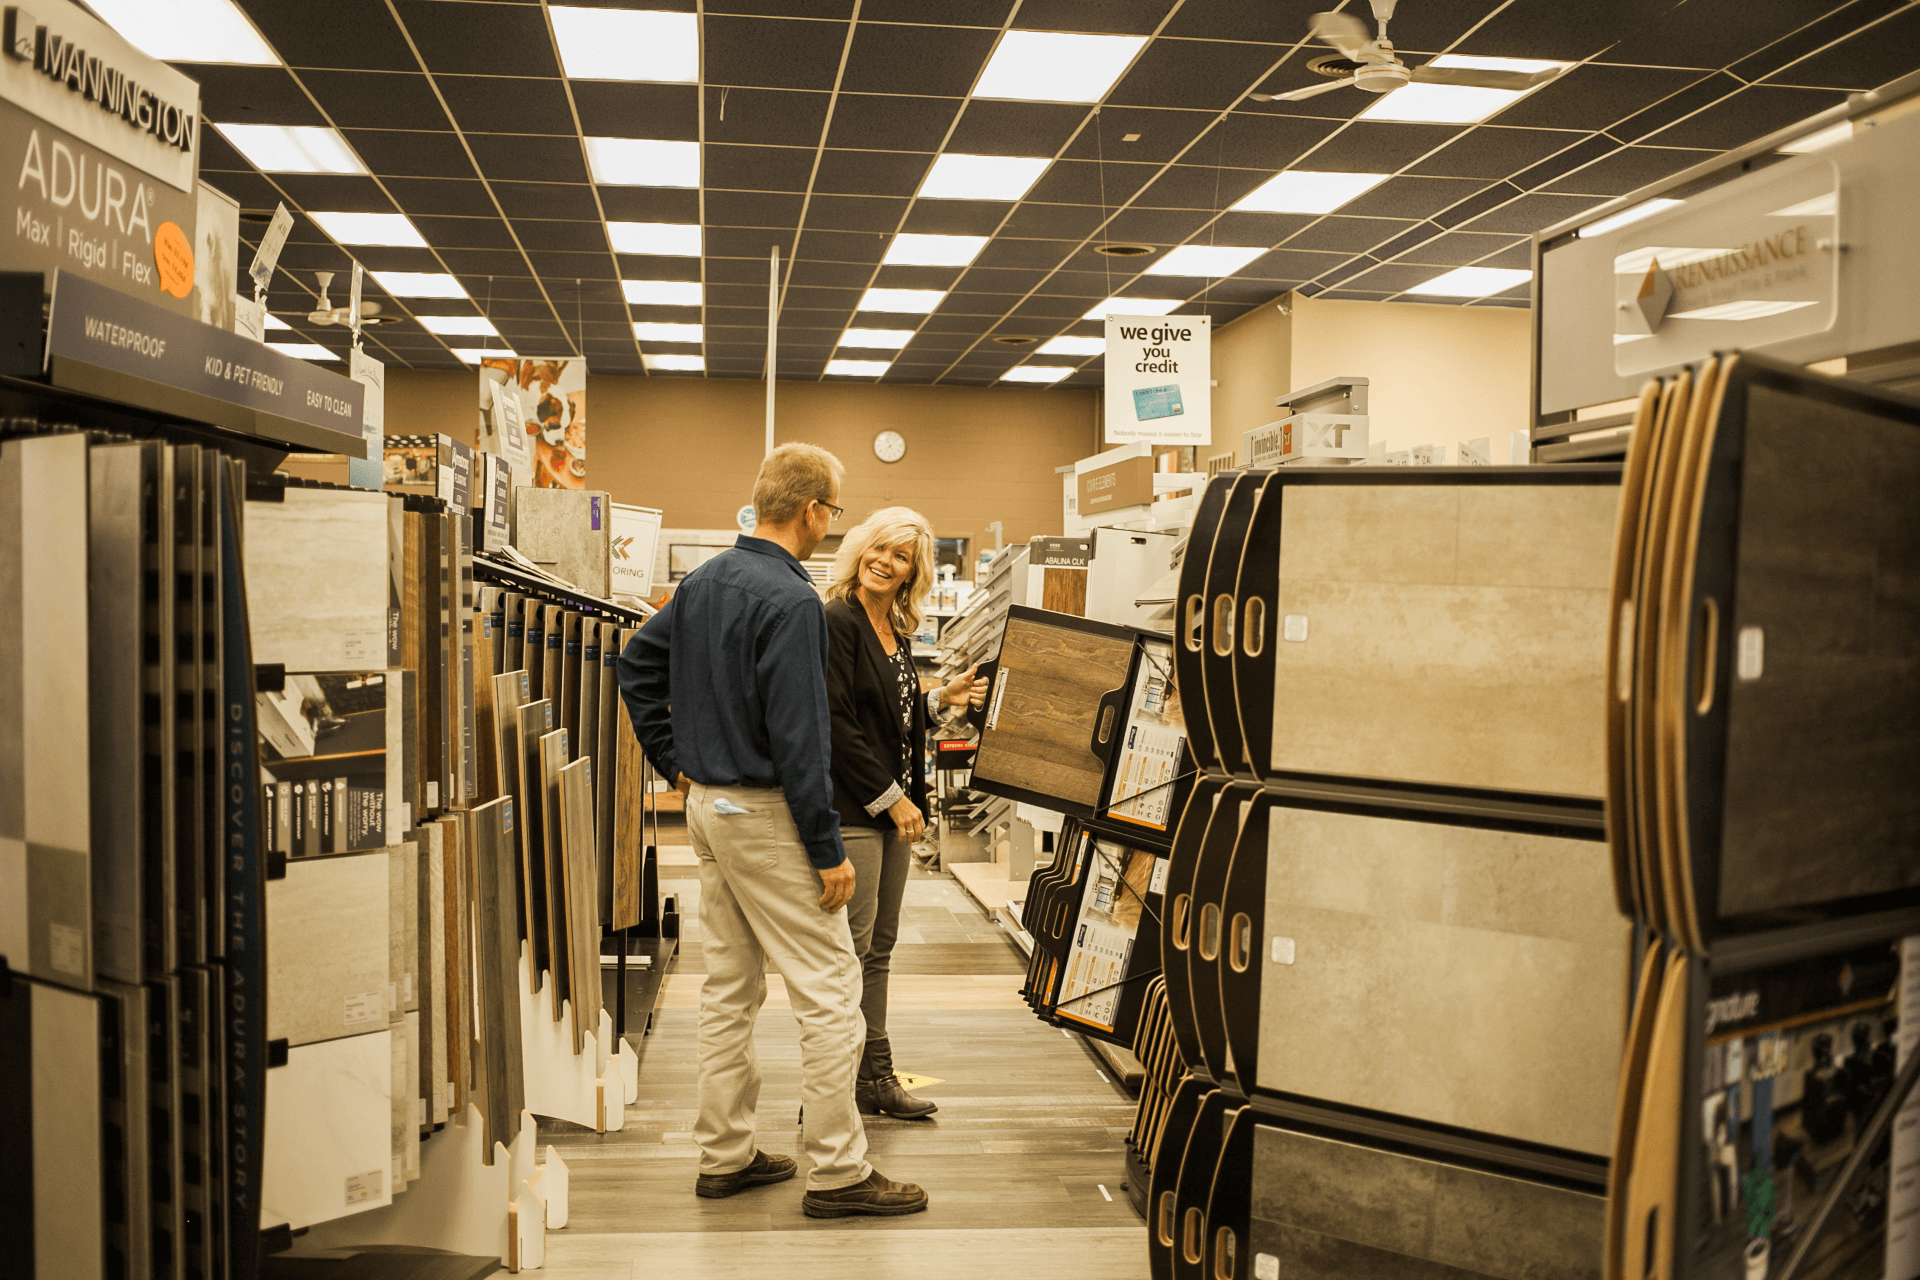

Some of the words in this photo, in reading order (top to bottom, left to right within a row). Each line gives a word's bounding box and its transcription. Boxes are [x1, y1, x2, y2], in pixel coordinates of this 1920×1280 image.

[36, 26, 196, 152] MANNINGTON
[16, 206, 50, 247] Max
[68, 228, 107, 268] Rigid
[122, 251, 151, 285] Flex
[1675, 226, 1805, 290] RENAISSANCE
[85, 316, 166, 359] WATERPROOF
[1120, 326, 1148, 340] we
[1151, 322, 1192, 346] give
[1135, 359, 1179, 374] credit
[1142, 347, 1171, 361] you
[204, 356, 223, 377] KID
[224, 362, 232, 380] &
[233, 365, 251, 385] PET
[251, 370, 284, 396] FRIENDLY
[306, 389, 323, 409] EASY
[324, 395, 333, 412] TO
[332, 399, 353, 418] CLEAN
[1113, 429, 1137, 438] Nobody
[1137, 430, 1157, 438] makes
[1307, 422, 1351, 449] XT
[612, 566, 644, 578] ORING
[1044, 556, 1071, 566] ABALINA
[1071, 557, 1085, 566] CLK
[391, 611, 400, 628] The
[231, 703, 245, 872] DISCOVER
[362, 791, 370, 808] the
[375, 792, 384, 809] The
[368, 791, 376, 827] without
[232, 892, 245, 950] THE
[1704, 990, 1760, 1034] gnature
[233, 1103, 248, 1210] STORY
